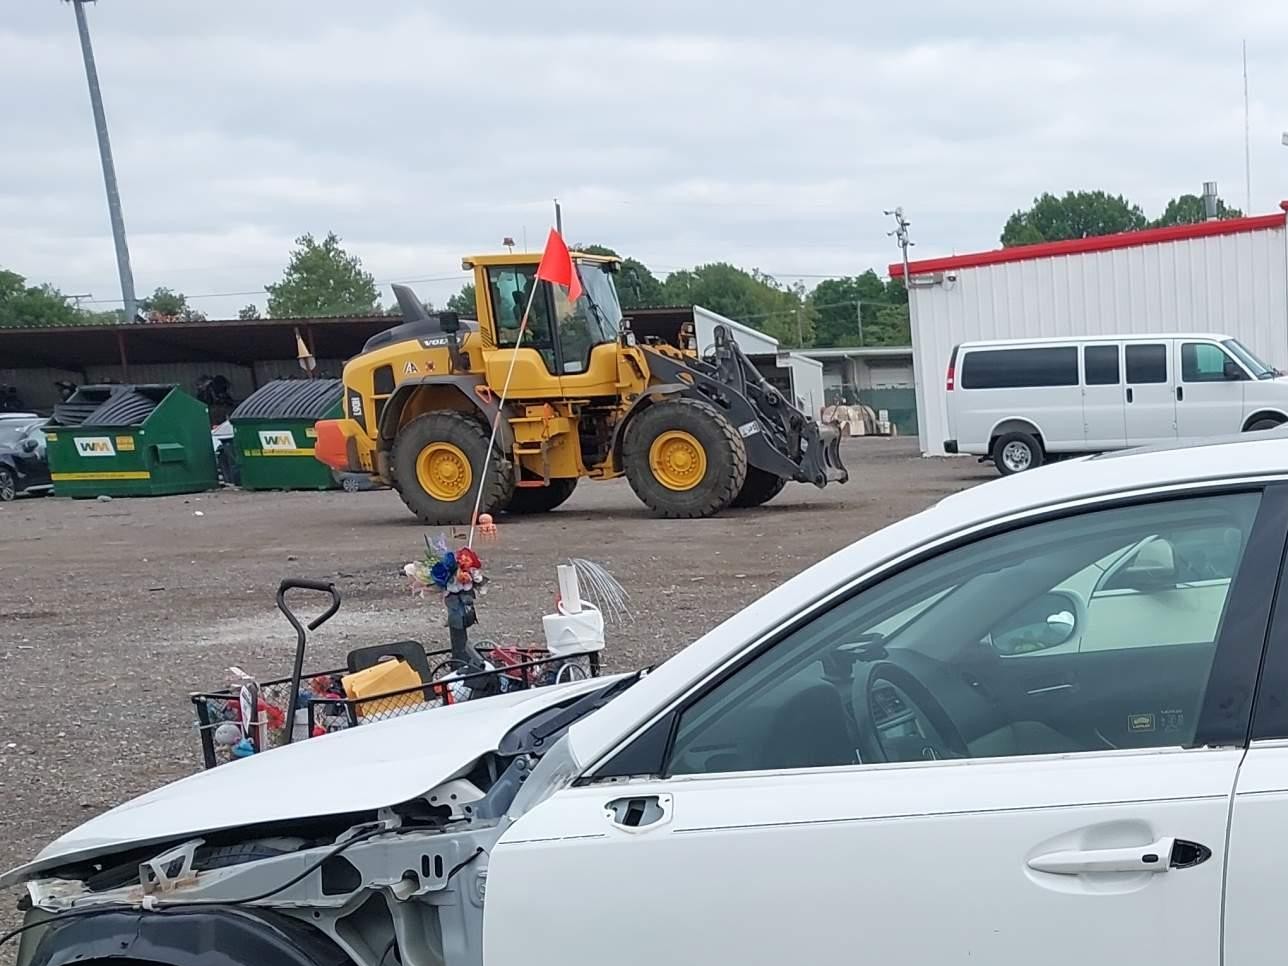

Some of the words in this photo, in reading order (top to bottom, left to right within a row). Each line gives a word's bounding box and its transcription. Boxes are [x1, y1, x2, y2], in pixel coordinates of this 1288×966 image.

[423, 337, 461, 346] VOLO
[264, 435, 291, 445] WM
[79, 442, 111, 451] WM
